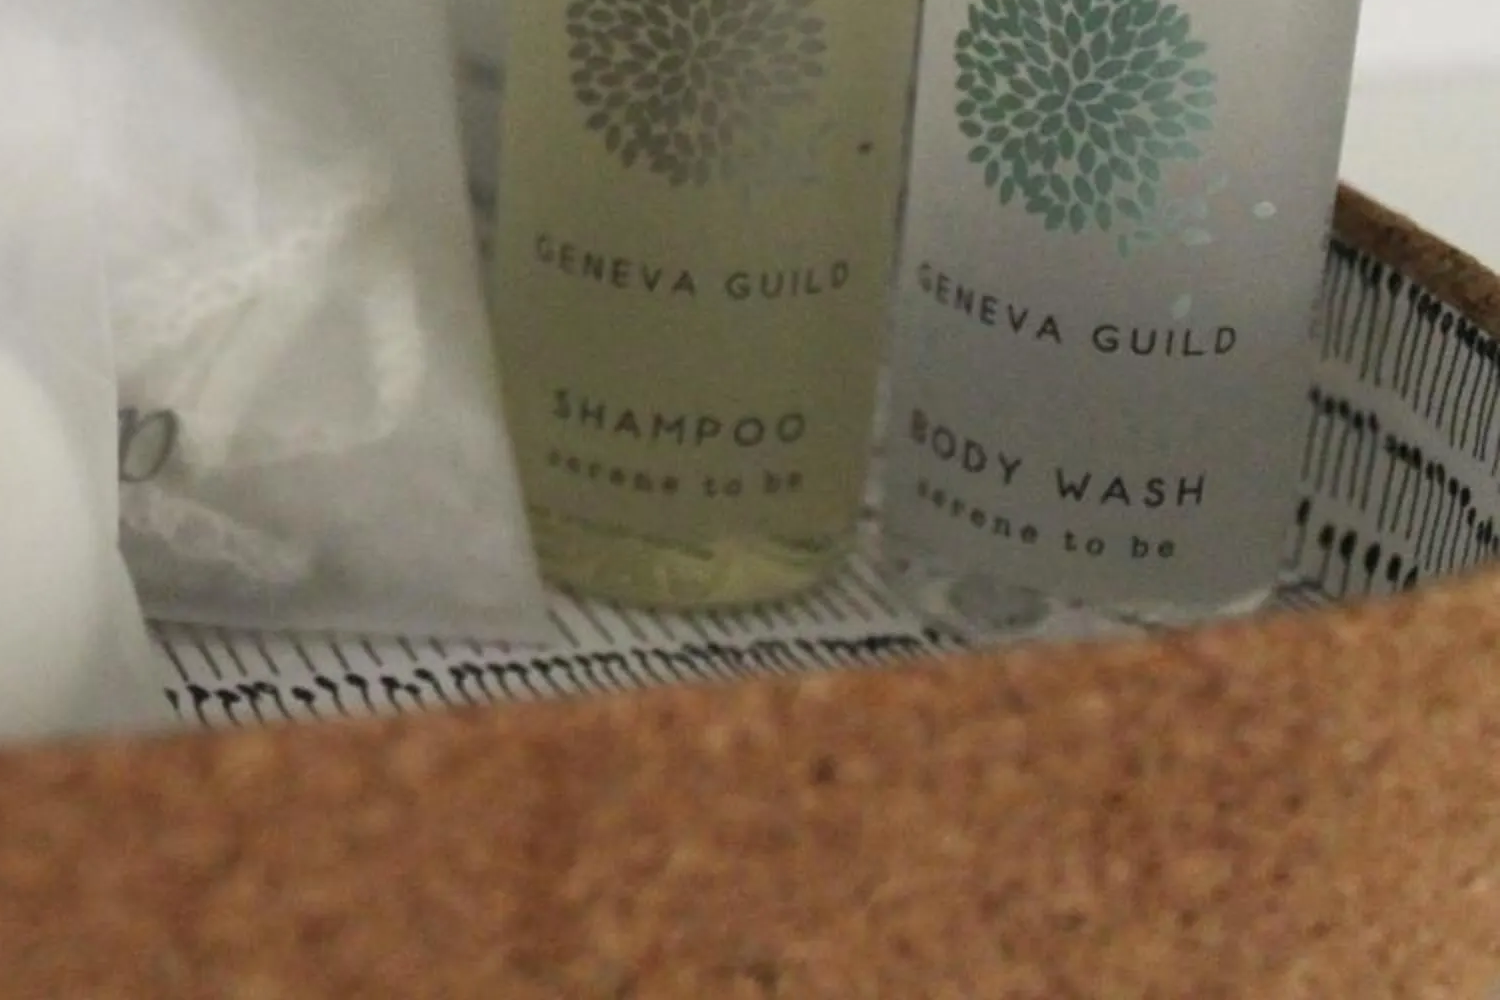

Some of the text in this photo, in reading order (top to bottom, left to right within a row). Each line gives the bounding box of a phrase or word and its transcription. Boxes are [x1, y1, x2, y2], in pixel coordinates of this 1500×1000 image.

[536, 232, 850, 300] GENEVA GUILD
[917, 261, 1237, 357] GENEVA GUILD
[553, 388, 807, 448] SHAMPOO
[547, 449, 803, 498] serene to be
[909, 408, 1206, 508] BODY WASH
[917, 480, 1175, 559] serene to be
